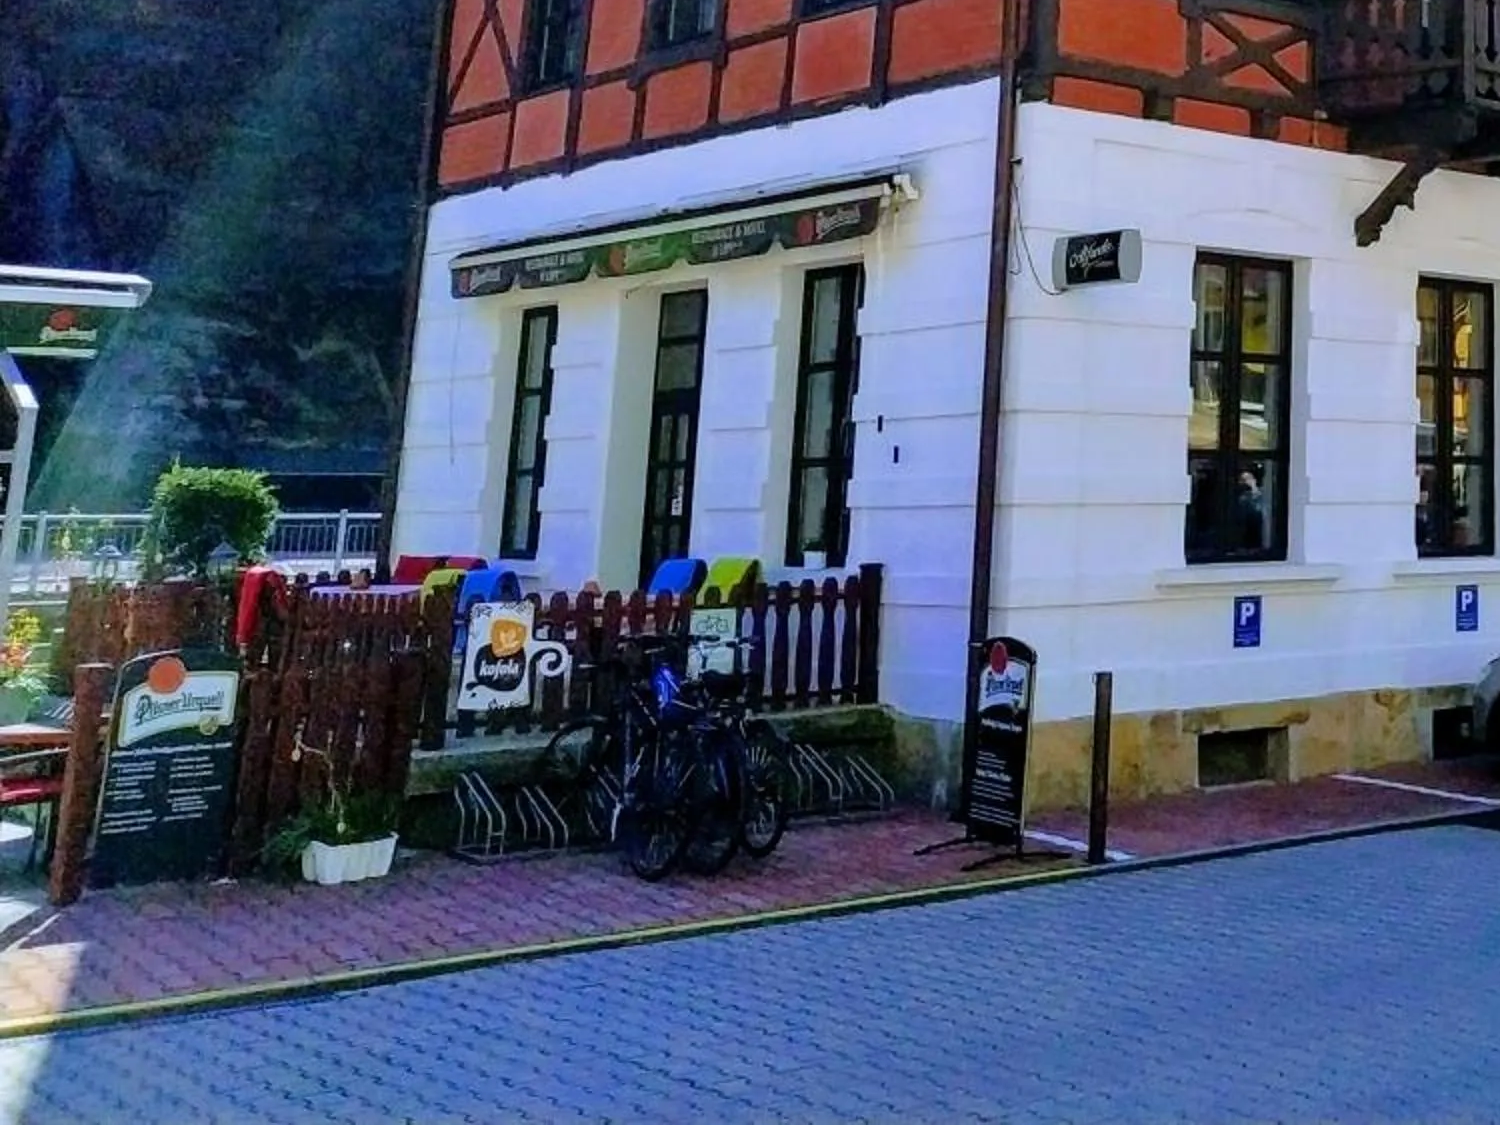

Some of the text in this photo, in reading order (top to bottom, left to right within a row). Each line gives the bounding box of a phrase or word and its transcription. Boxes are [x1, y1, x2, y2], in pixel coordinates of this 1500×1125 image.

[1461, 591, 1473, 611] P
[1240, 602, 1255, 625] P
[135, 691, 225, 725] Pilsner Urquell
